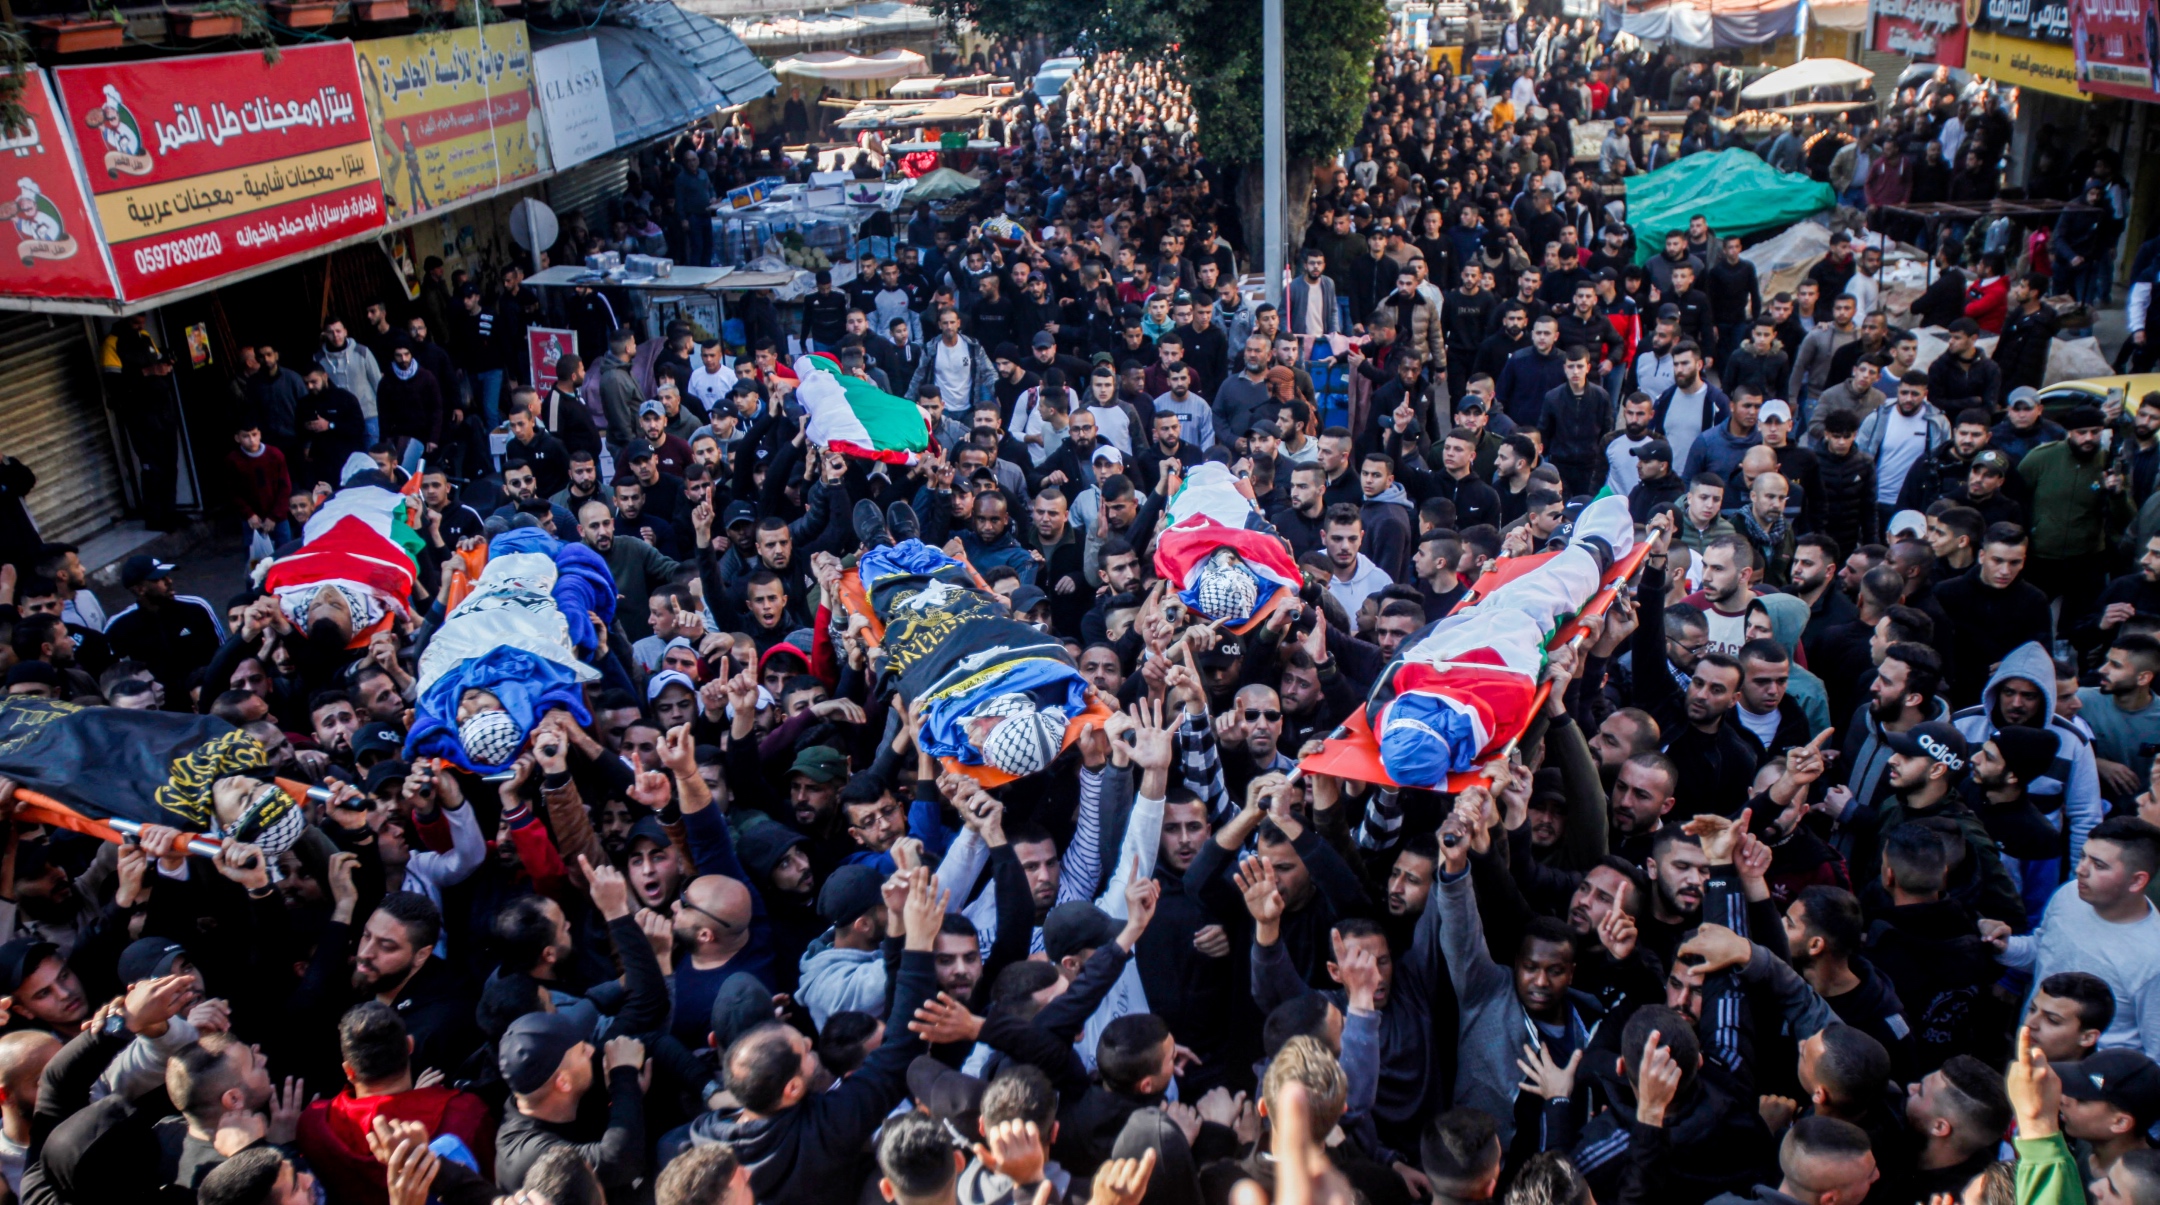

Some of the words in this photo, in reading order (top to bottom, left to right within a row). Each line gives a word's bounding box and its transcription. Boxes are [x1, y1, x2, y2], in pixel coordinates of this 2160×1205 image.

[378, 55, 432, 102] الجاهزة
[546, 69, 600, 101] CLASSY
[241, 96, 321, 134] ومعجنات
[319, 86, 355, 124] بيتزا
[154, 102, 207, 156] القمر
[207, 102, 243, 147] طل
[243, 165, 285, 201] شامية
[285, 164, 334, 188] معجنات
[343, 154, 366, 178] بيتزا
[127, 196, 173, 227] عربية
[174, 188, 234, 213] معجنات
[304, 203, 319, 232] أبو
[318, 200, 350, 228] فرسان
[279, 214, 305, 237] حماد
[134, 231, 222, 276] 0597830220
[1919, 734, 1965, 771] adida
